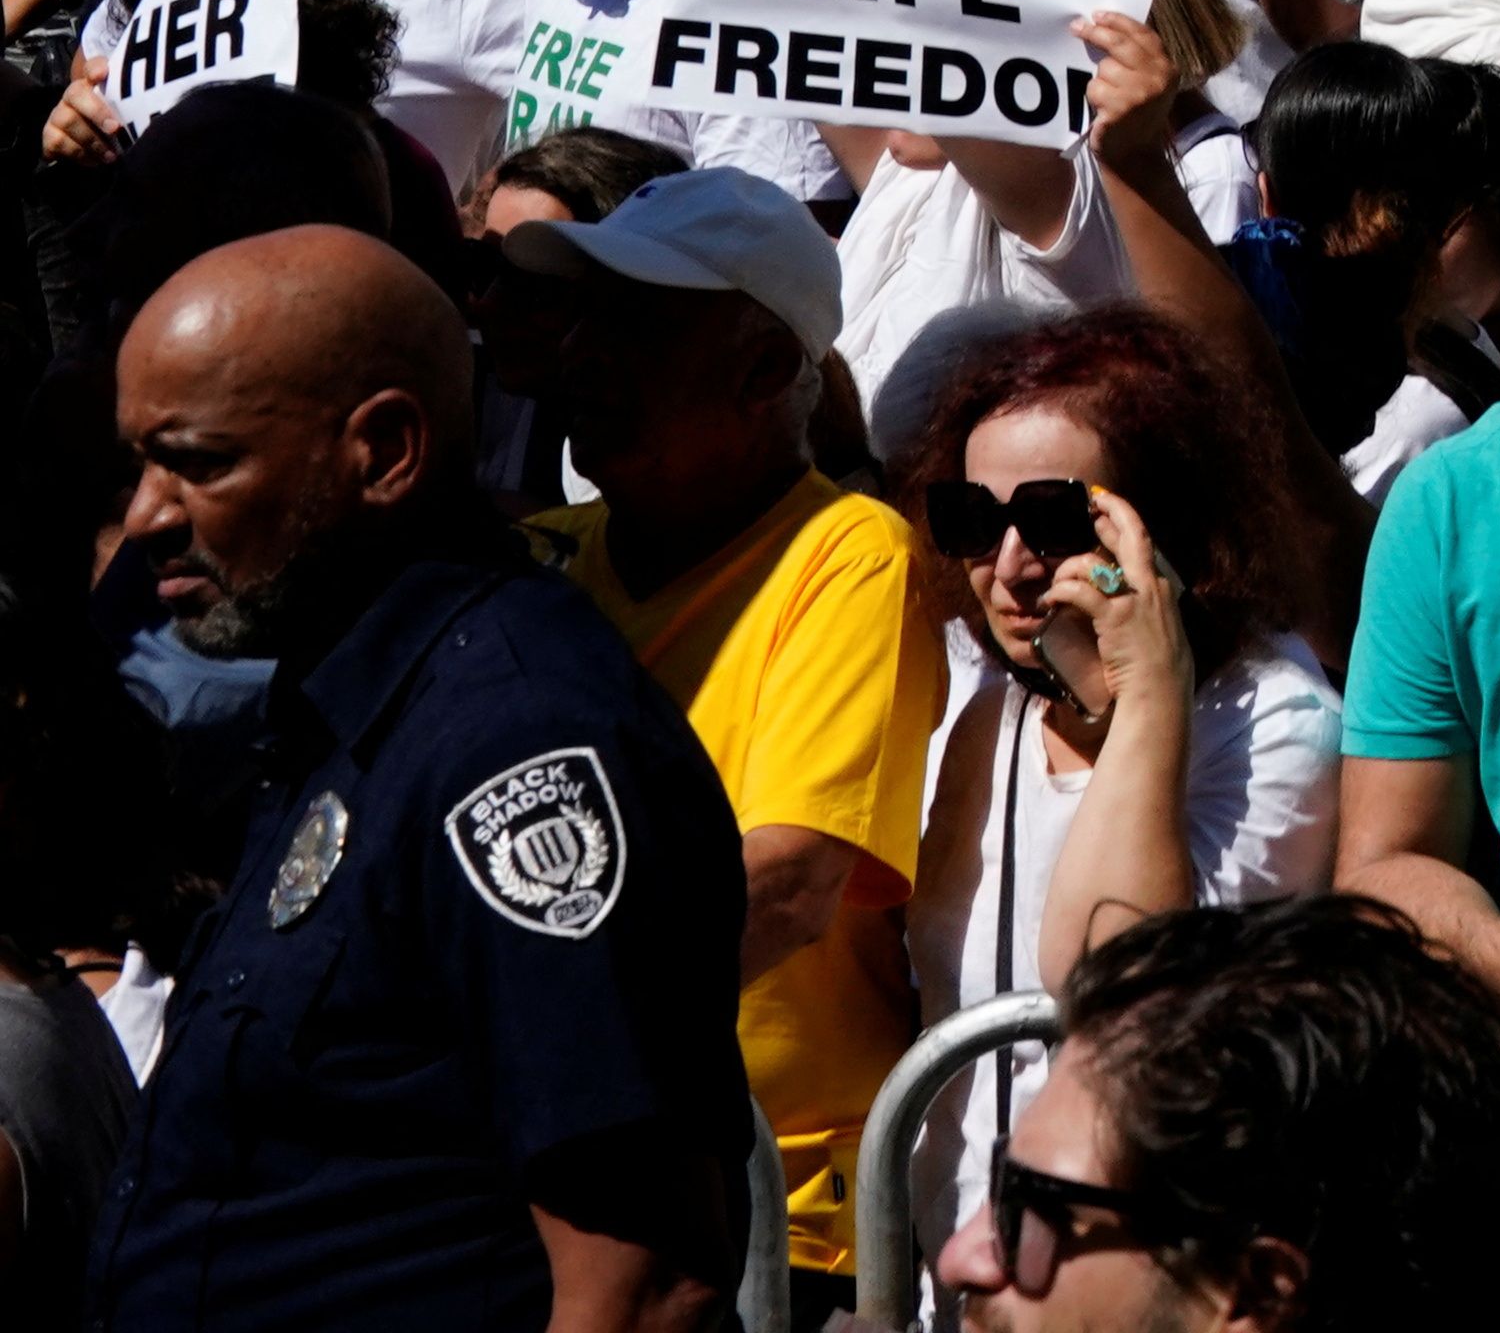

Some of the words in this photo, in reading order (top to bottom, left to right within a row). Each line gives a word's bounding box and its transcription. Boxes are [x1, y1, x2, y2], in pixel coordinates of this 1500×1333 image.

[516, 20, 625, 101] FREE
[470, 762, 570, 822] BLACK
[472, 780, 585, 845] SHADOW
